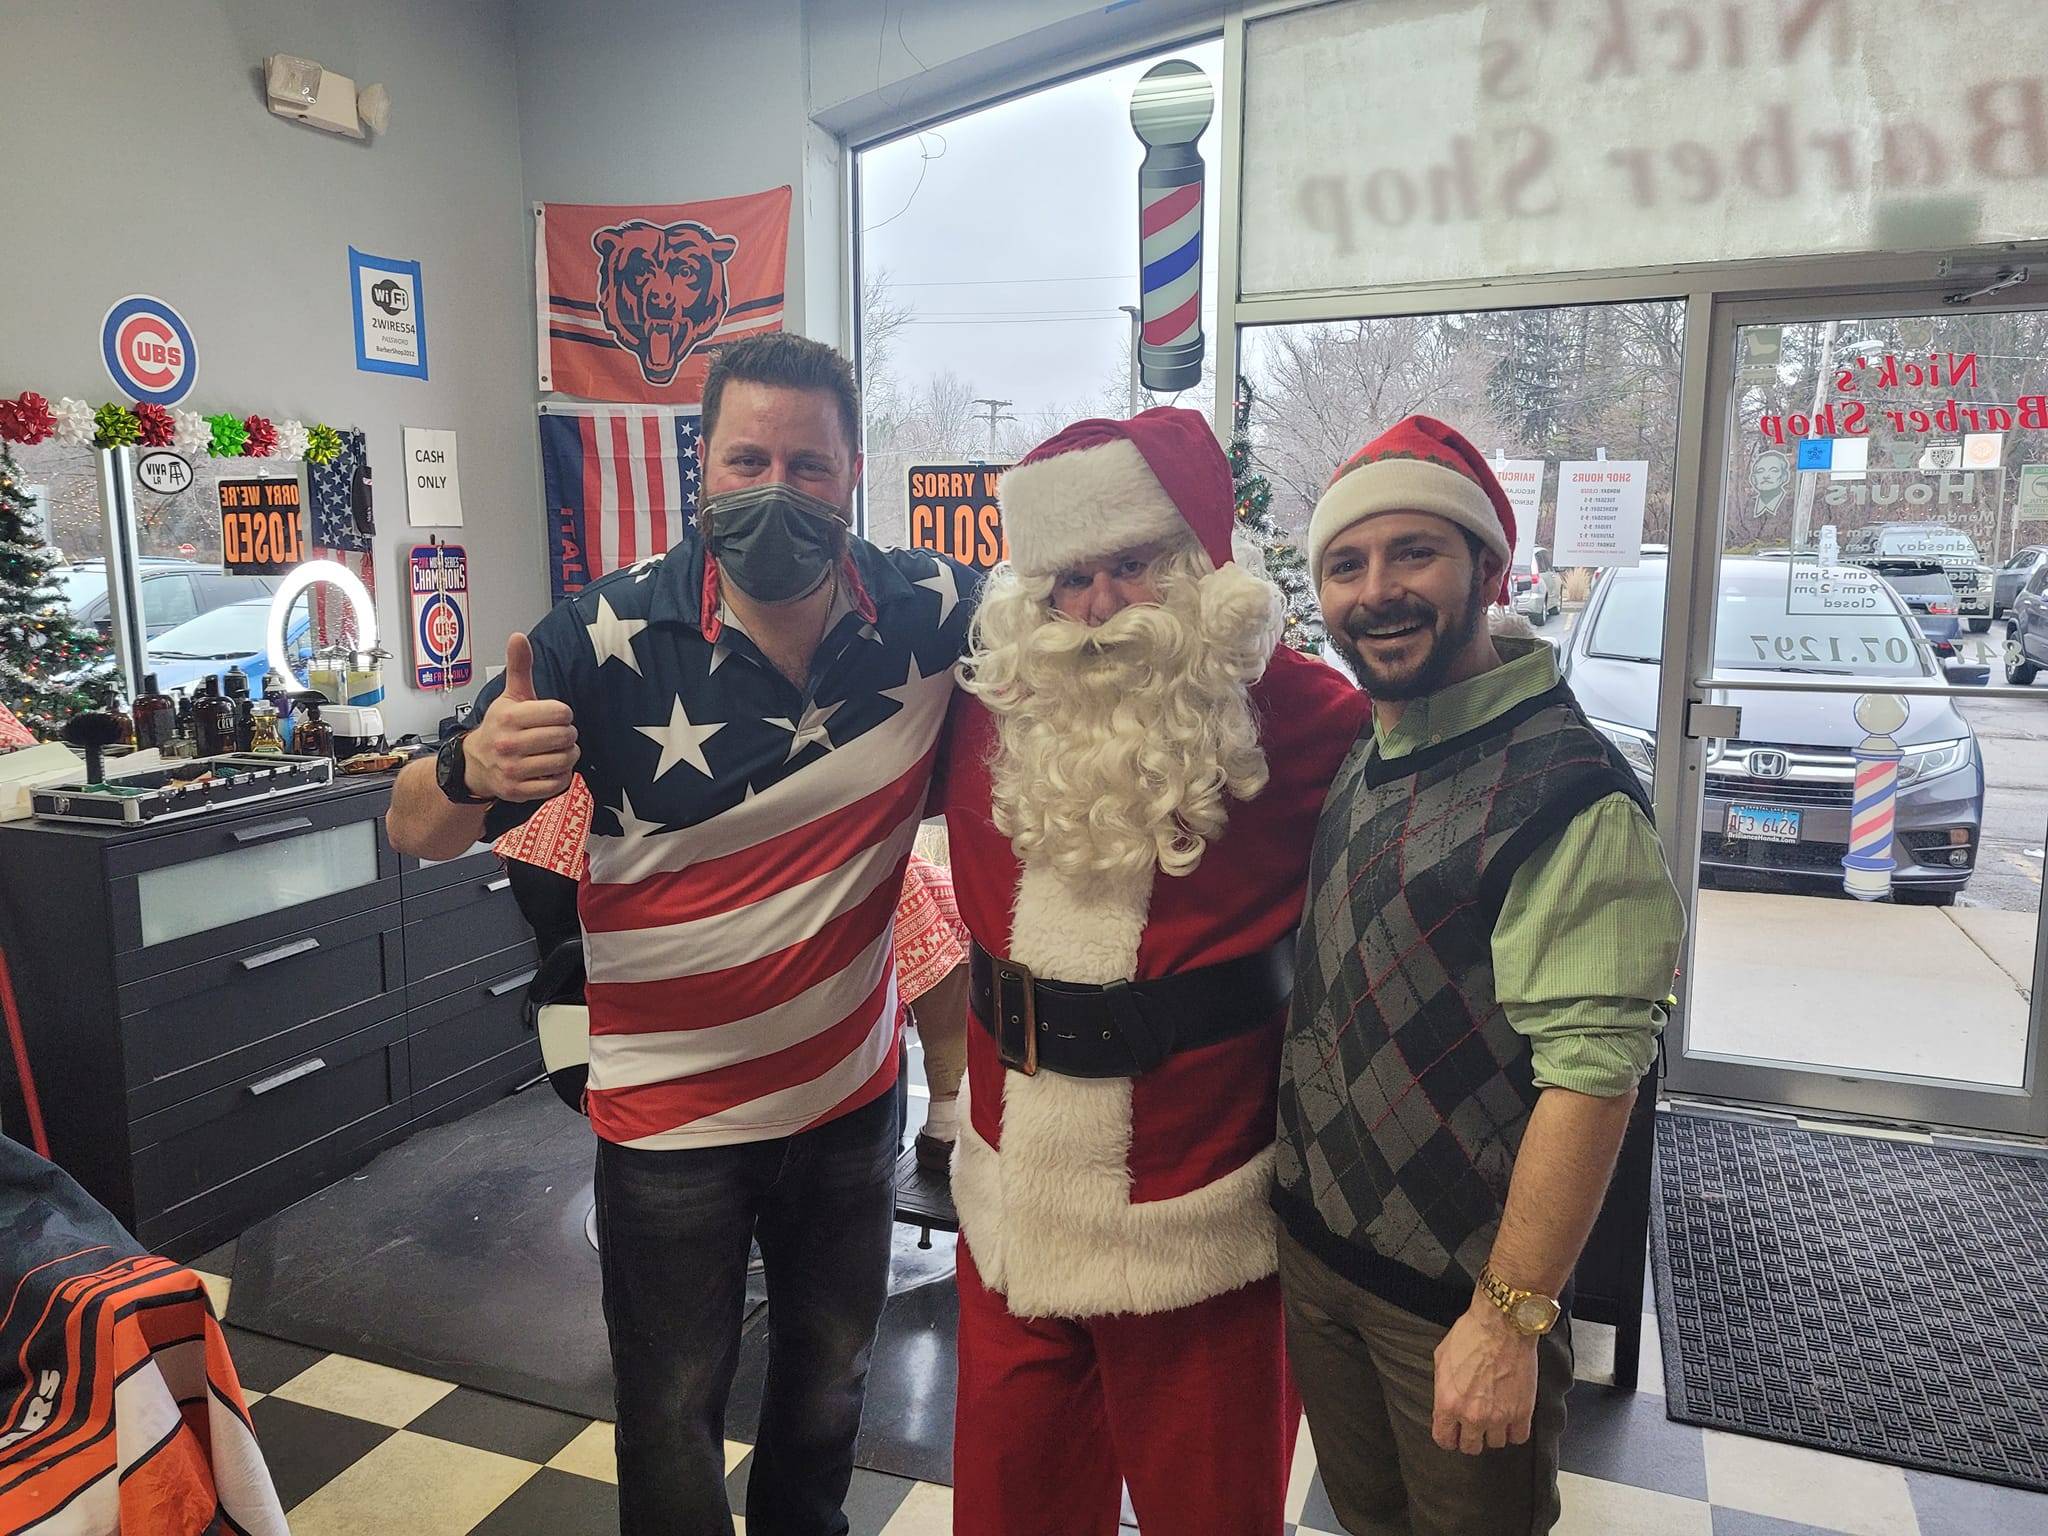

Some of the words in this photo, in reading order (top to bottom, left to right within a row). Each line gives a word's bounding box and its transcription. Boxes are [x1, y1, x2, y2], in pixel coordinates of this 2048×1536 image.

[120, 317, 182, 388] CUBS
[415, 449, 445, 463] CASH
[145, 463, 167, 476] VIVA
[153, 477, 162, 485] LA
[417, 475, 447, 489] ONLY
[912, 473, 976, 498] SORRY
[912, 504, 1010, 567] CLOS
[413, 564, 466, 590] CHAMIONS
[217, 717, 234, 730] CREW
[1762, 817, 1797, 836] 6426
